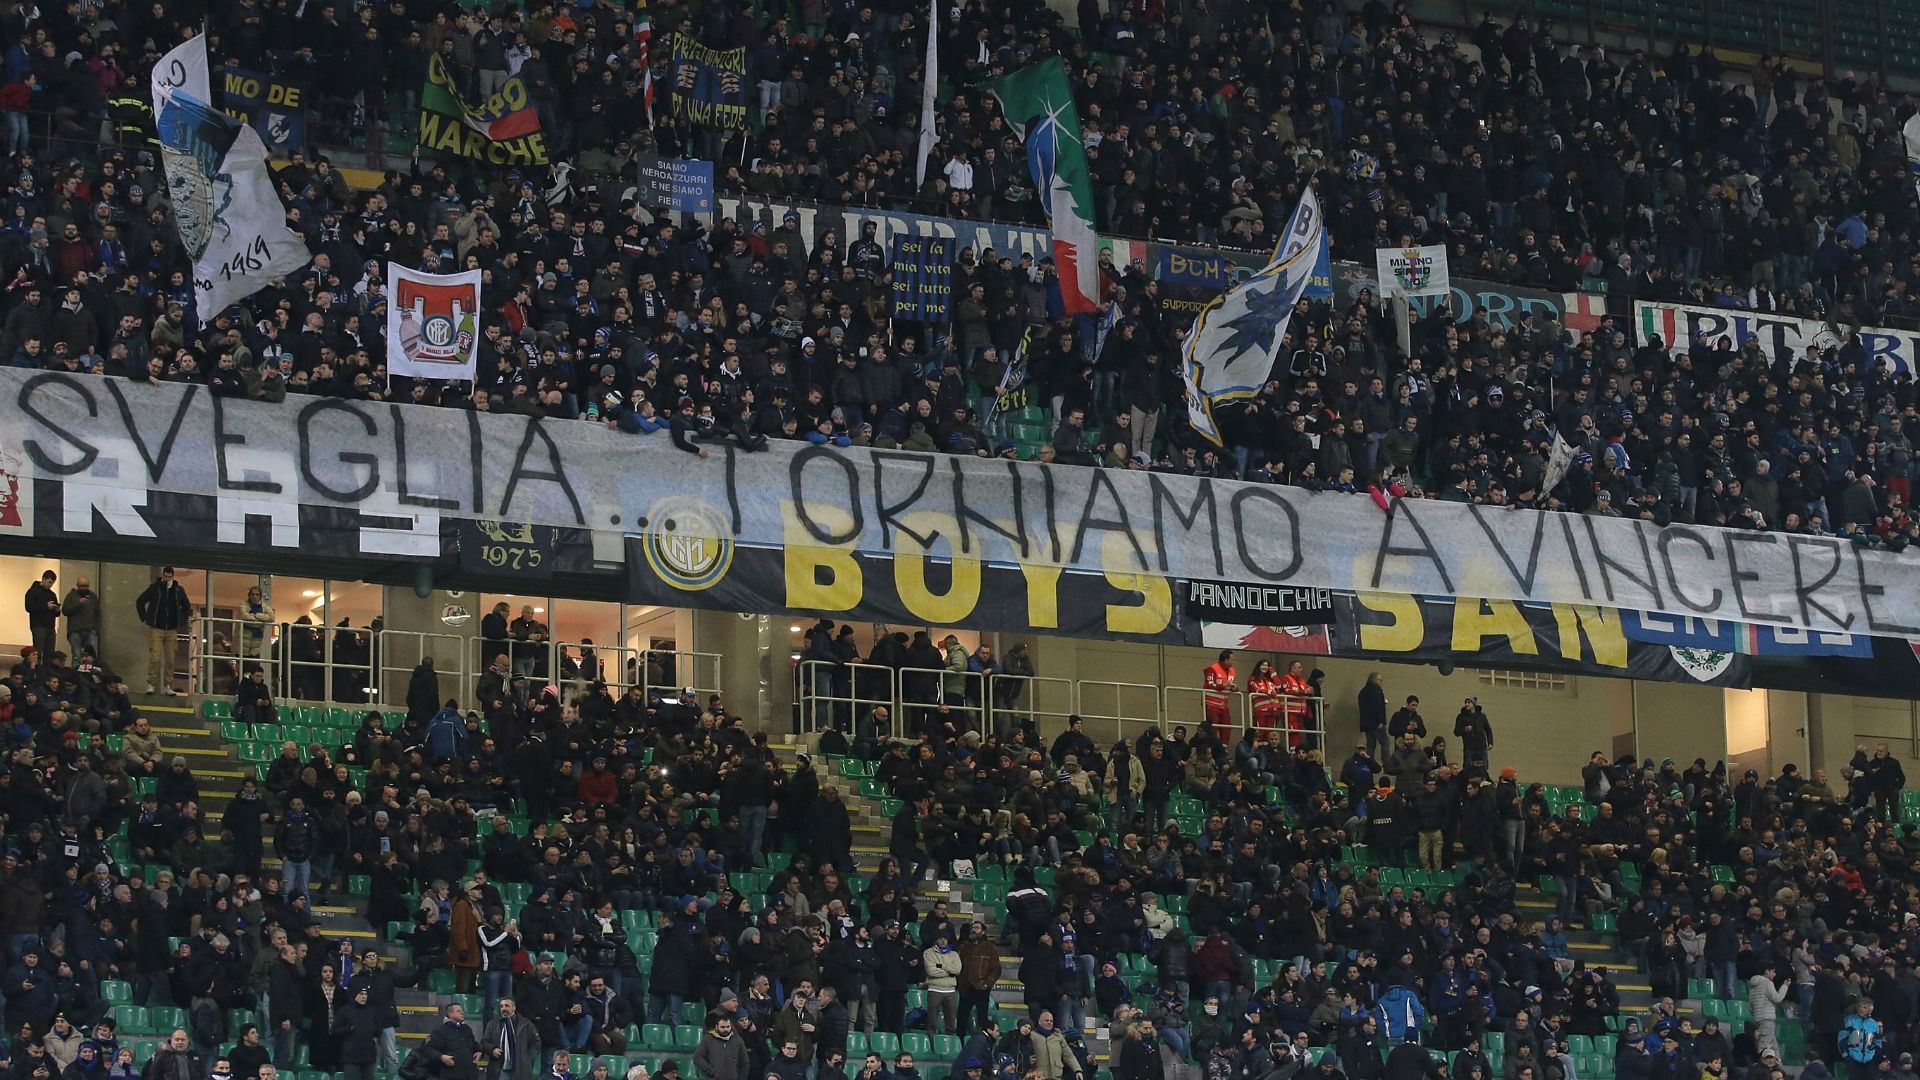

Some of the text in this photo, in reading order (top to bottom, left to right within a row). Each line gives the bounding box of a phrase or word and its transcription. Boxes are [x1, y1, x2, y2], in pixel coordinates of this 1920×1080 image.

[225, 73, 301, 108] MO DE
[687, 98, 711, 124] UNA
[715, 103, 746, 130] FEDE
[420, 111, 549, 166] MARCHE
[657, 160, 688, 173] SIAMO
[642, 167, 707, 184] NEROAZZURRI
[651, 180, 703, 196] E NE SIAMO
[658, 195, 681, 207] FIERI
[902, 241, 944, 255] sei la
[220, 234, 271, 281] 1969
[894, 260, 951, 275] mia vita
[892, 281, 951, 294] sei tutto
[894, 301, 946, 315] per me
[481, 545, 541, 569] 1975
[1361, 496, 1454, 593] A
[1467, 503, 1920, 635] VINCERE
